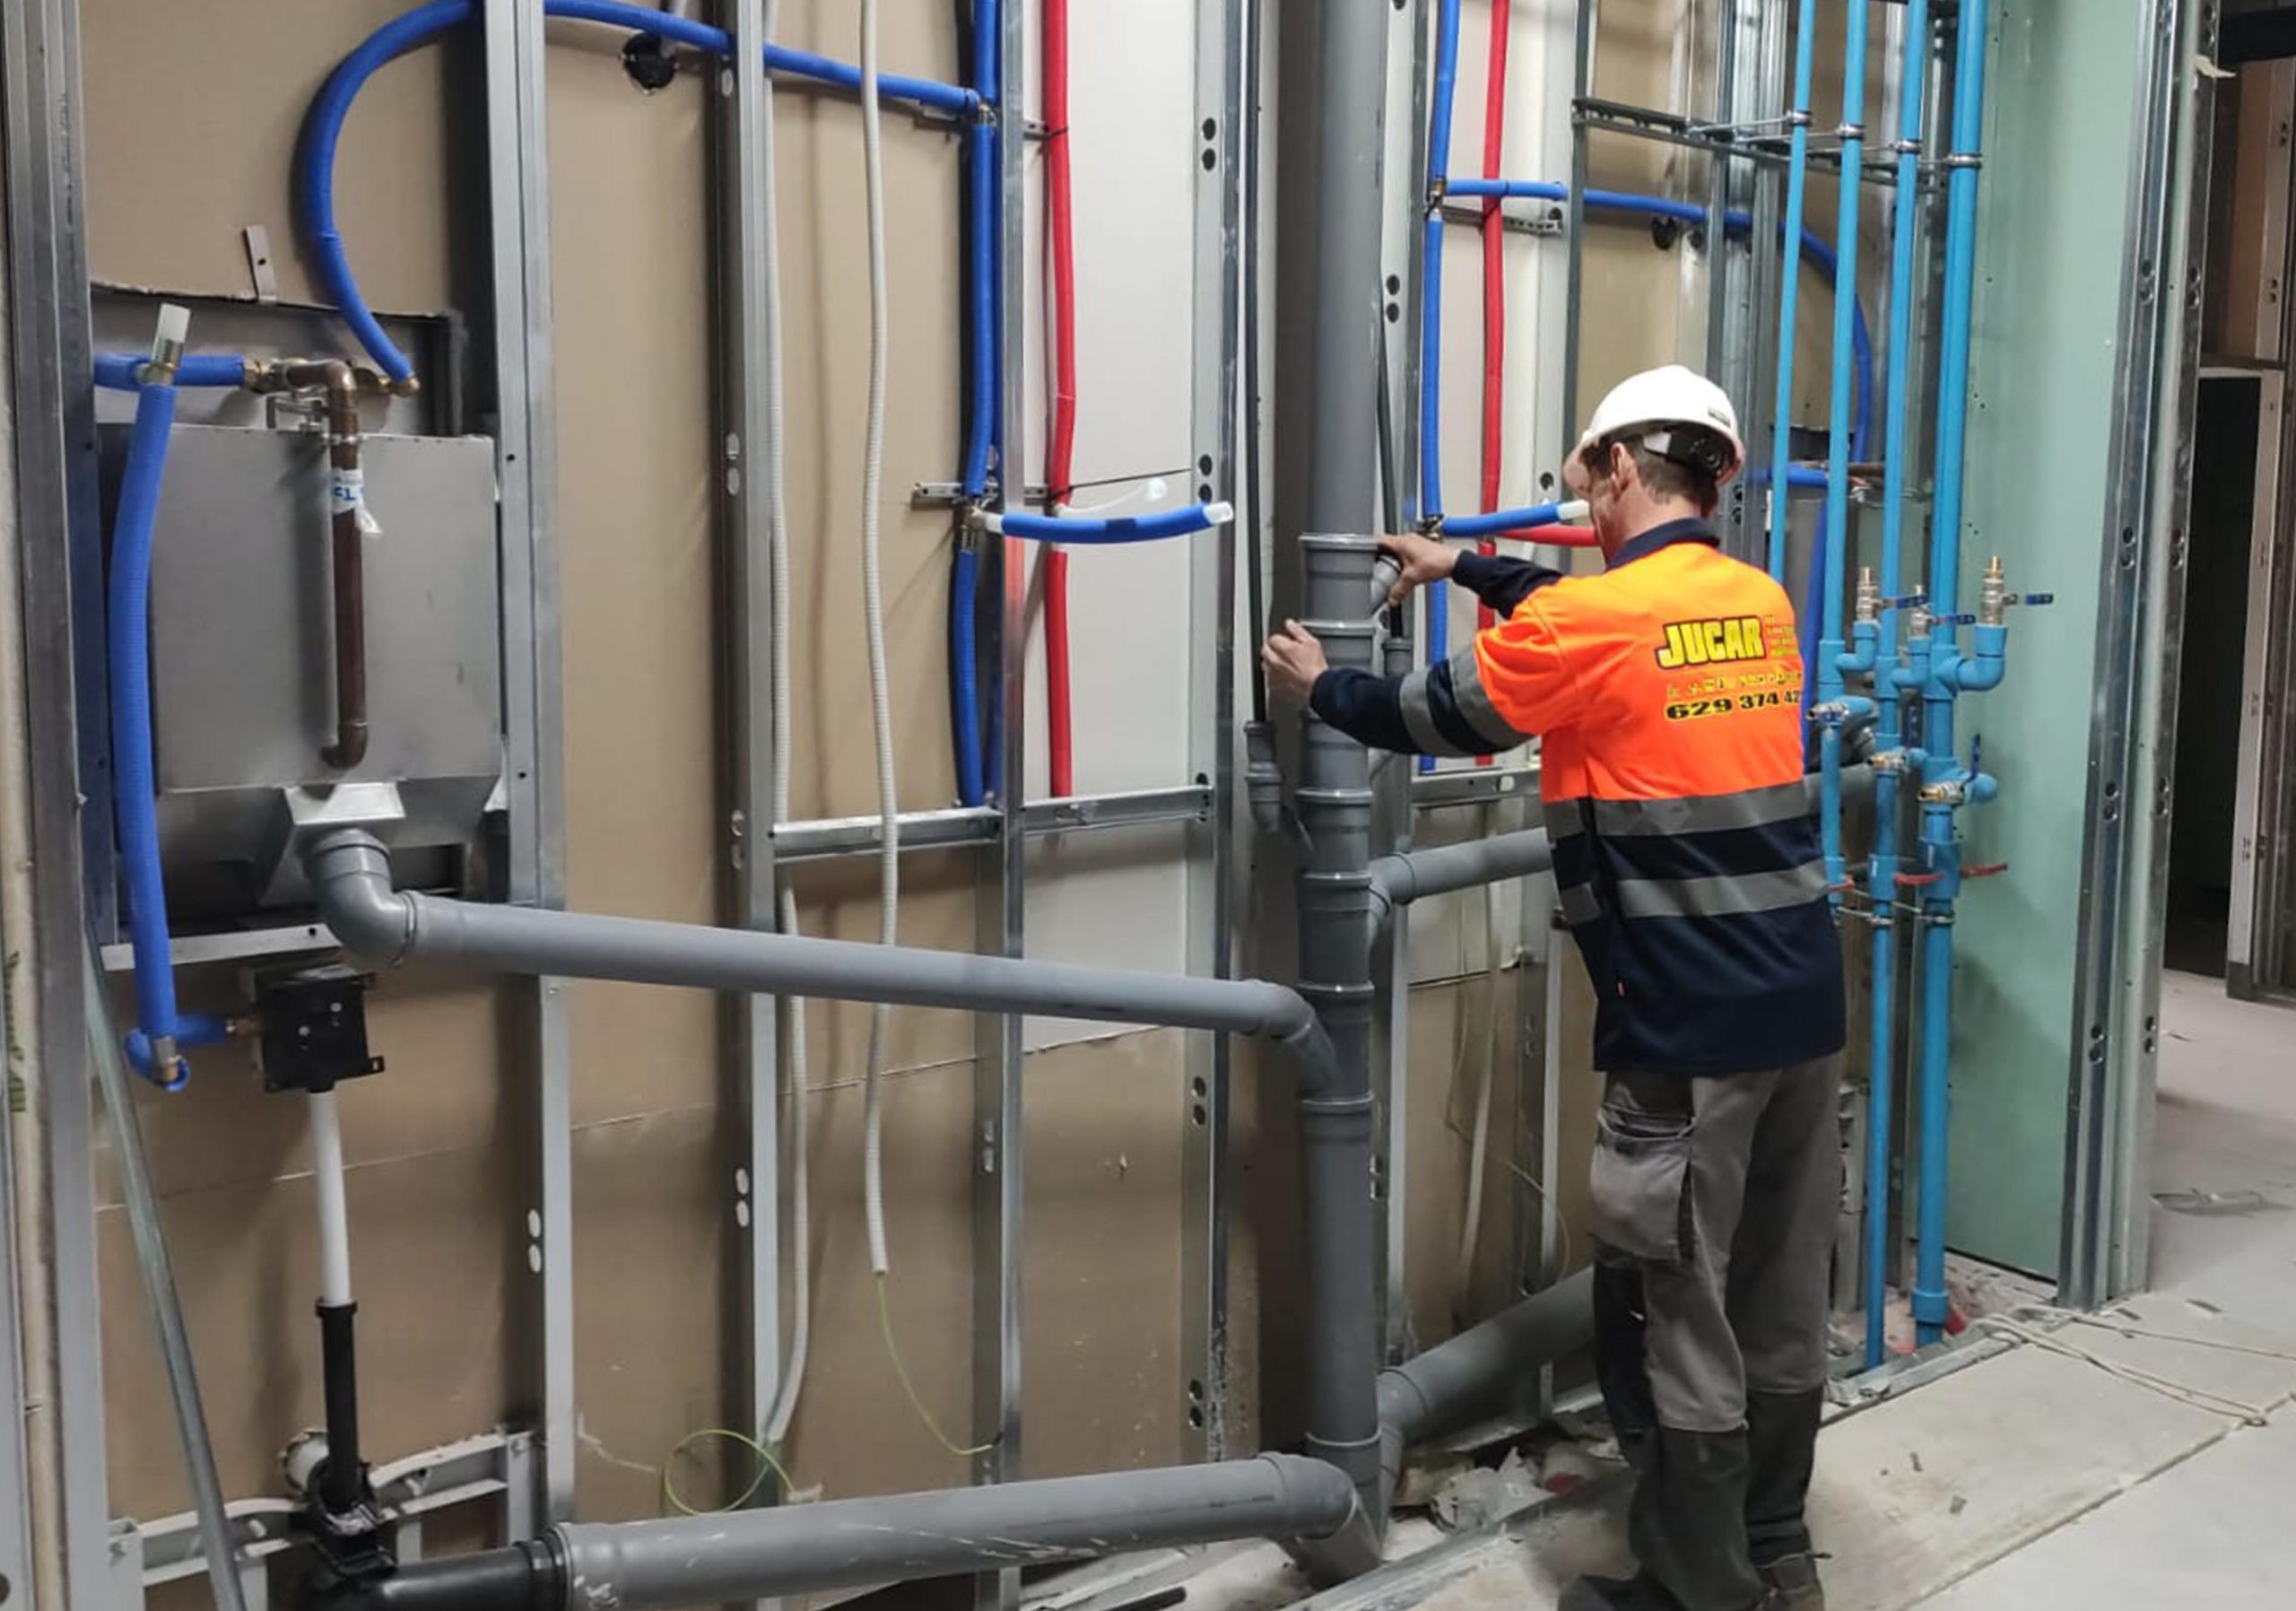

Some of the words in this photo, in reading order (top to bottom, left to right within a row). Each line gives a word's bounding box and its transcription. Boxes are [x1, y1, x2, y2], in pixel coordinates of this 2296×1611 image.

[1655, 615, 1766, 668] JUCAR
[1666, 698, 1733, 720] 629
[1739, 692, 1779, 710] 374
